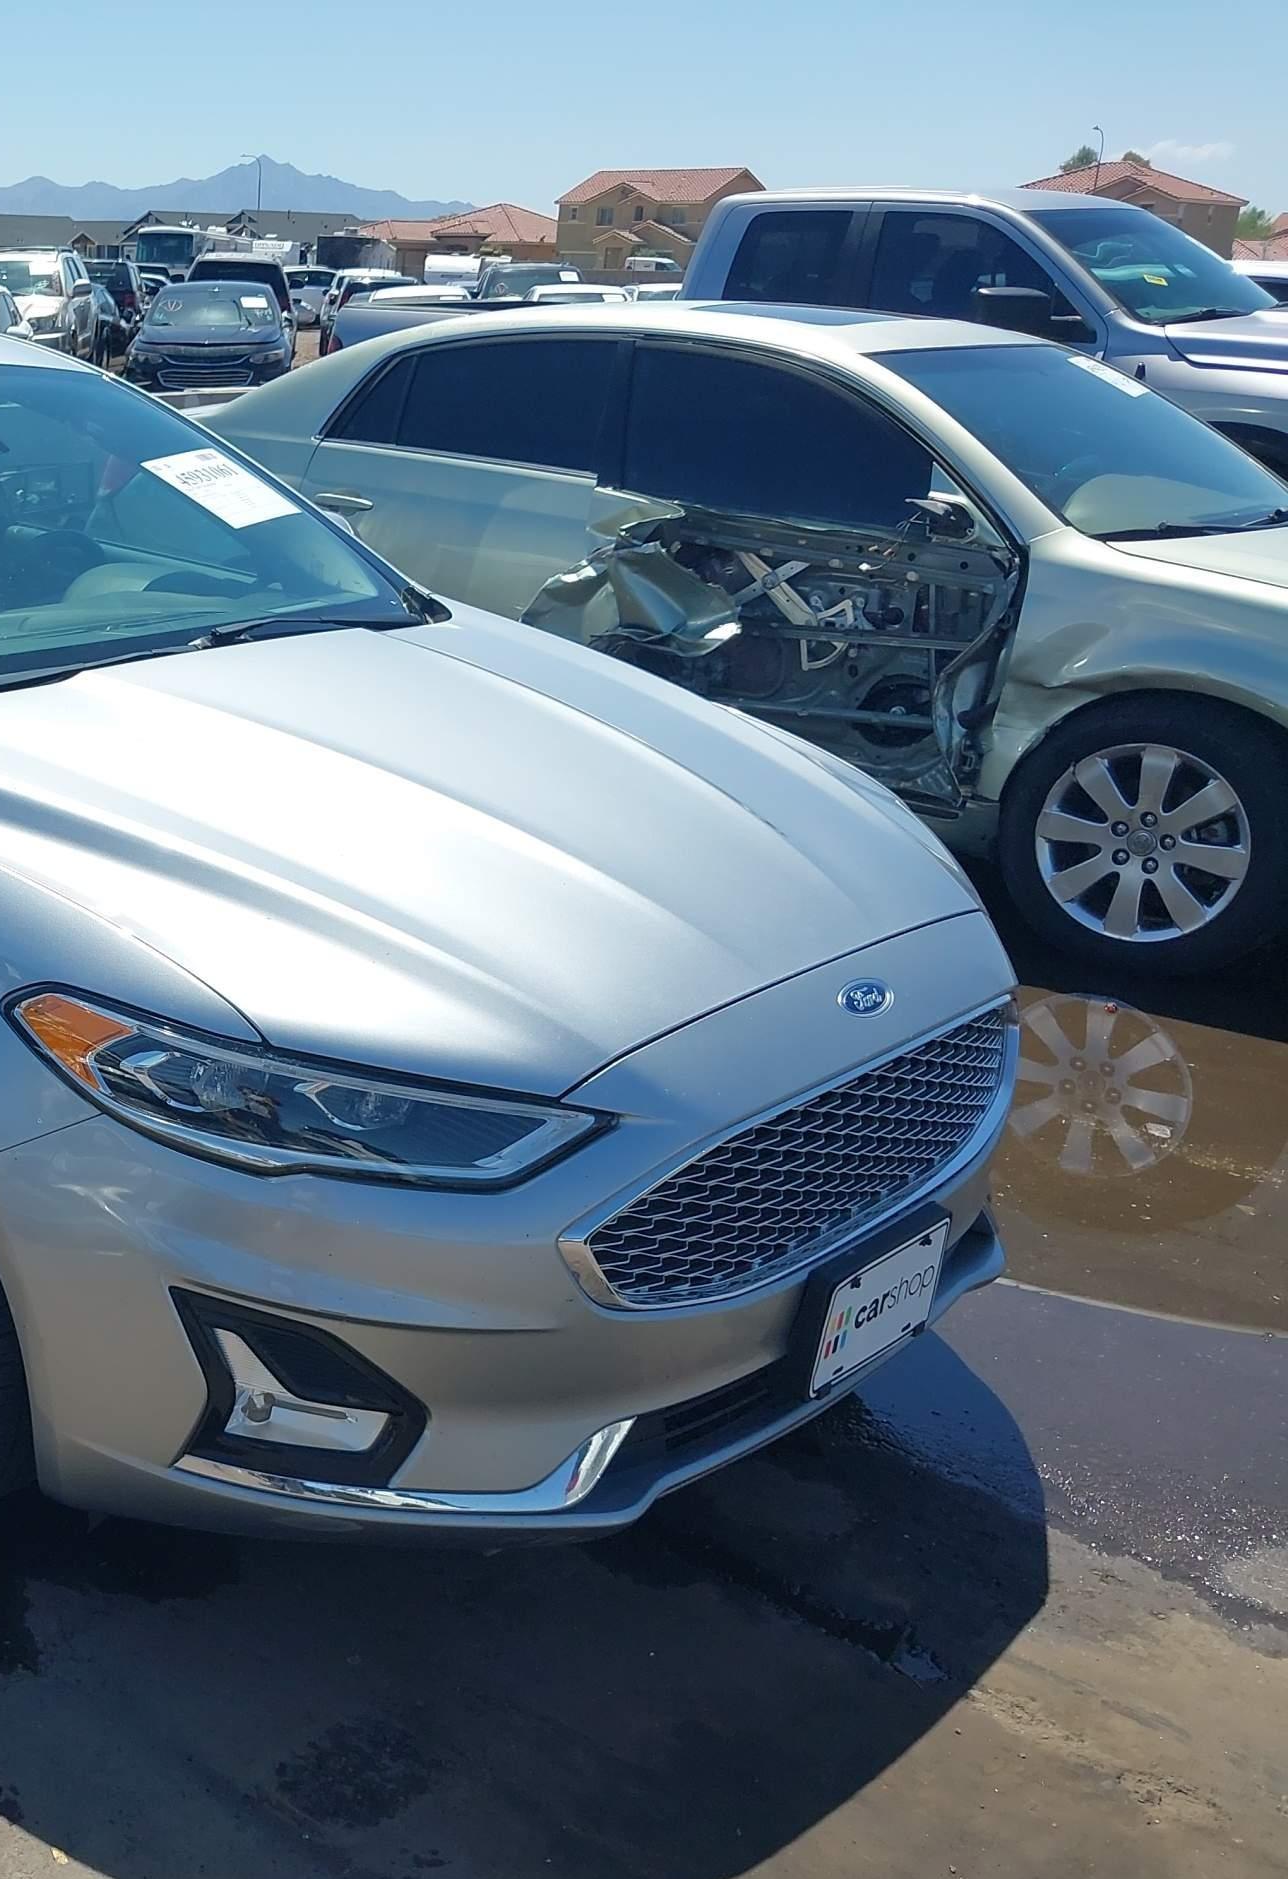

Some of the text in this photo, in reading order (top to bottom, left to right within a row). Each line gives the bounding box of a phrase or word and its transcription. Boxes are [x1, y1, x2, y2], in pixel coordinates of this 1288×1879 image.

[175, 463, 239, 487] 45931061
[850, 986, 883, 1011] Ford
[854, 1265, 935, 1329] carshop
